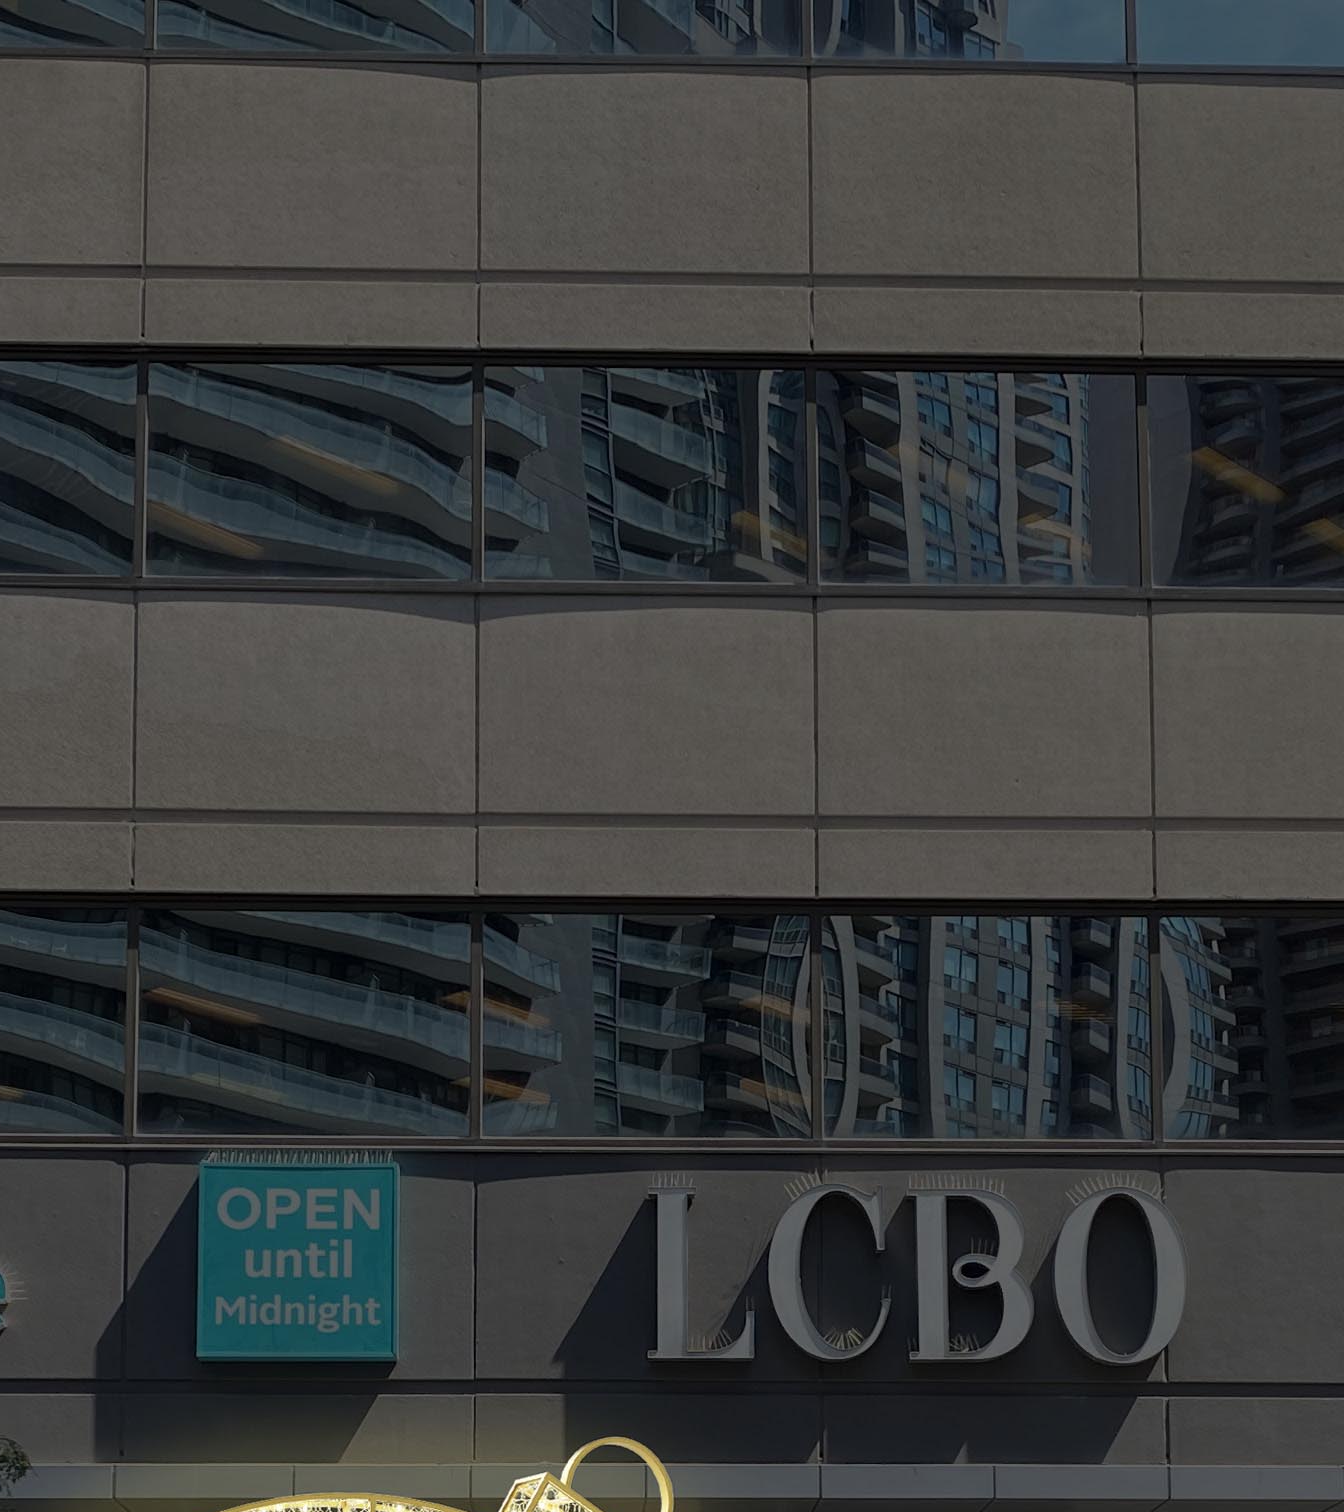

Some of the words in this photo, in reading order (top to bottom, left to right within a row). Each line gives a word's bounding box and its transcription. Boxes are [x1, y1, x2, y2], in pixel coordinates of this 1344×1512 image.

[216, 1186, 381, 1230] OPEN
[243, 1238, 353, 1279] until
[647, 1183, 1188, 1367] LCBO
[214, 1294, 382, 1334] Midnight
